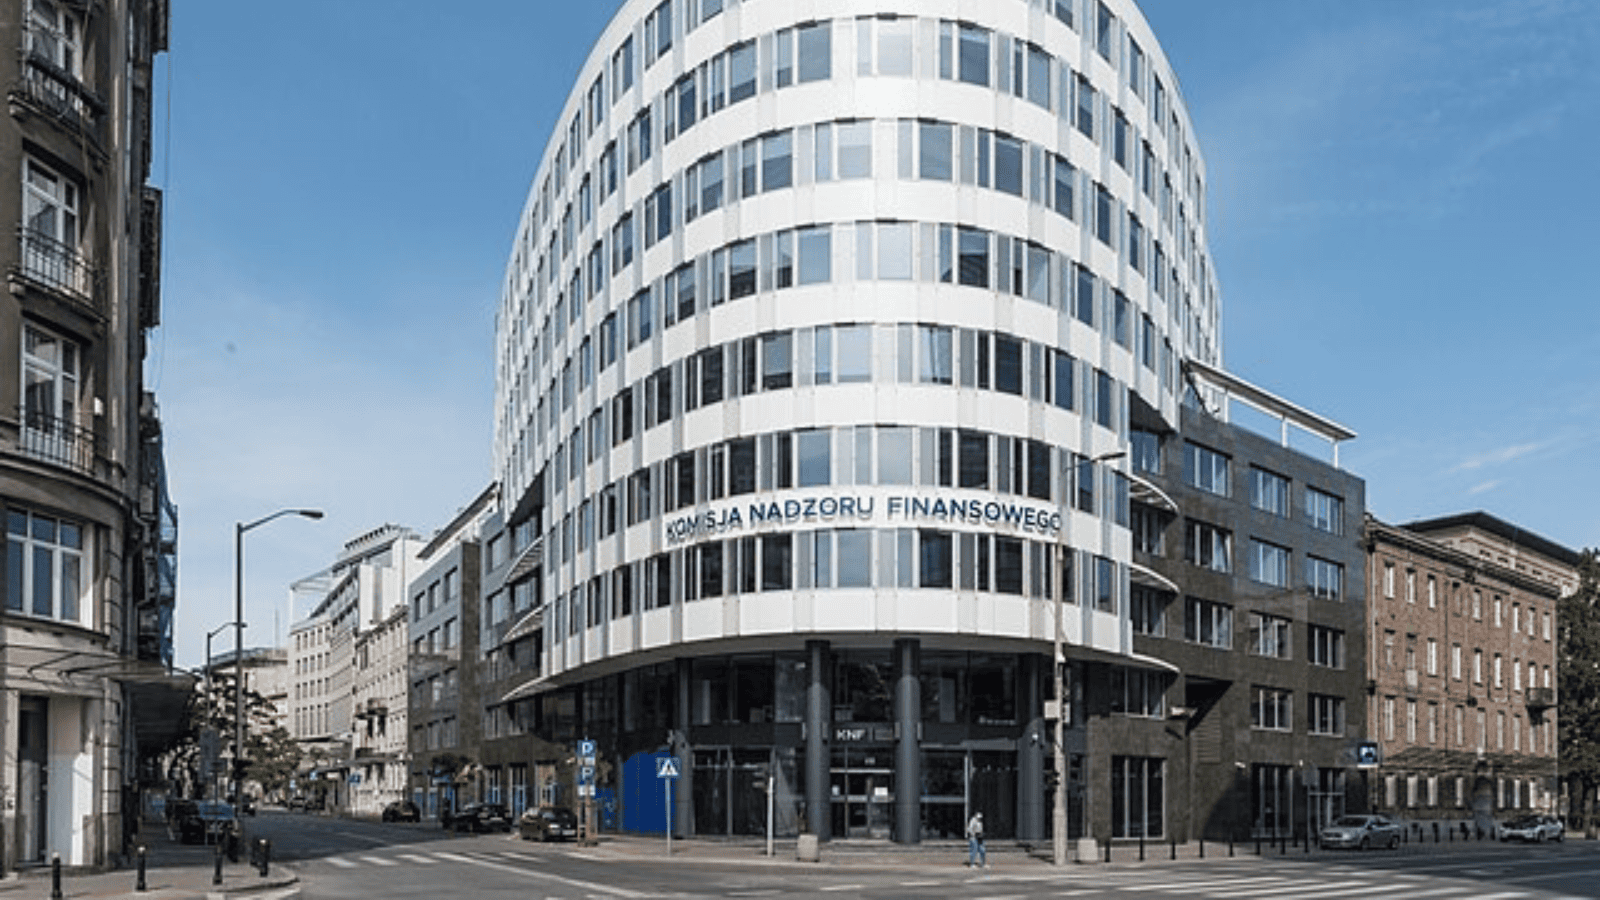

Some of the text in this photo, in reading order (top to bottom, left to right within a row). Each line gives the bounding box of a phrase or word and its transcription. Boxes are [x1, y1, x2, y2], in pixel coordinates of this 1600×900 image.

[749, 496, 873, 521] NADZORU
[888, 497, 1061, 530] FINANSOWEGO
[837, 729, 865, 740] KNF
[582, 742, 593, 755] P
